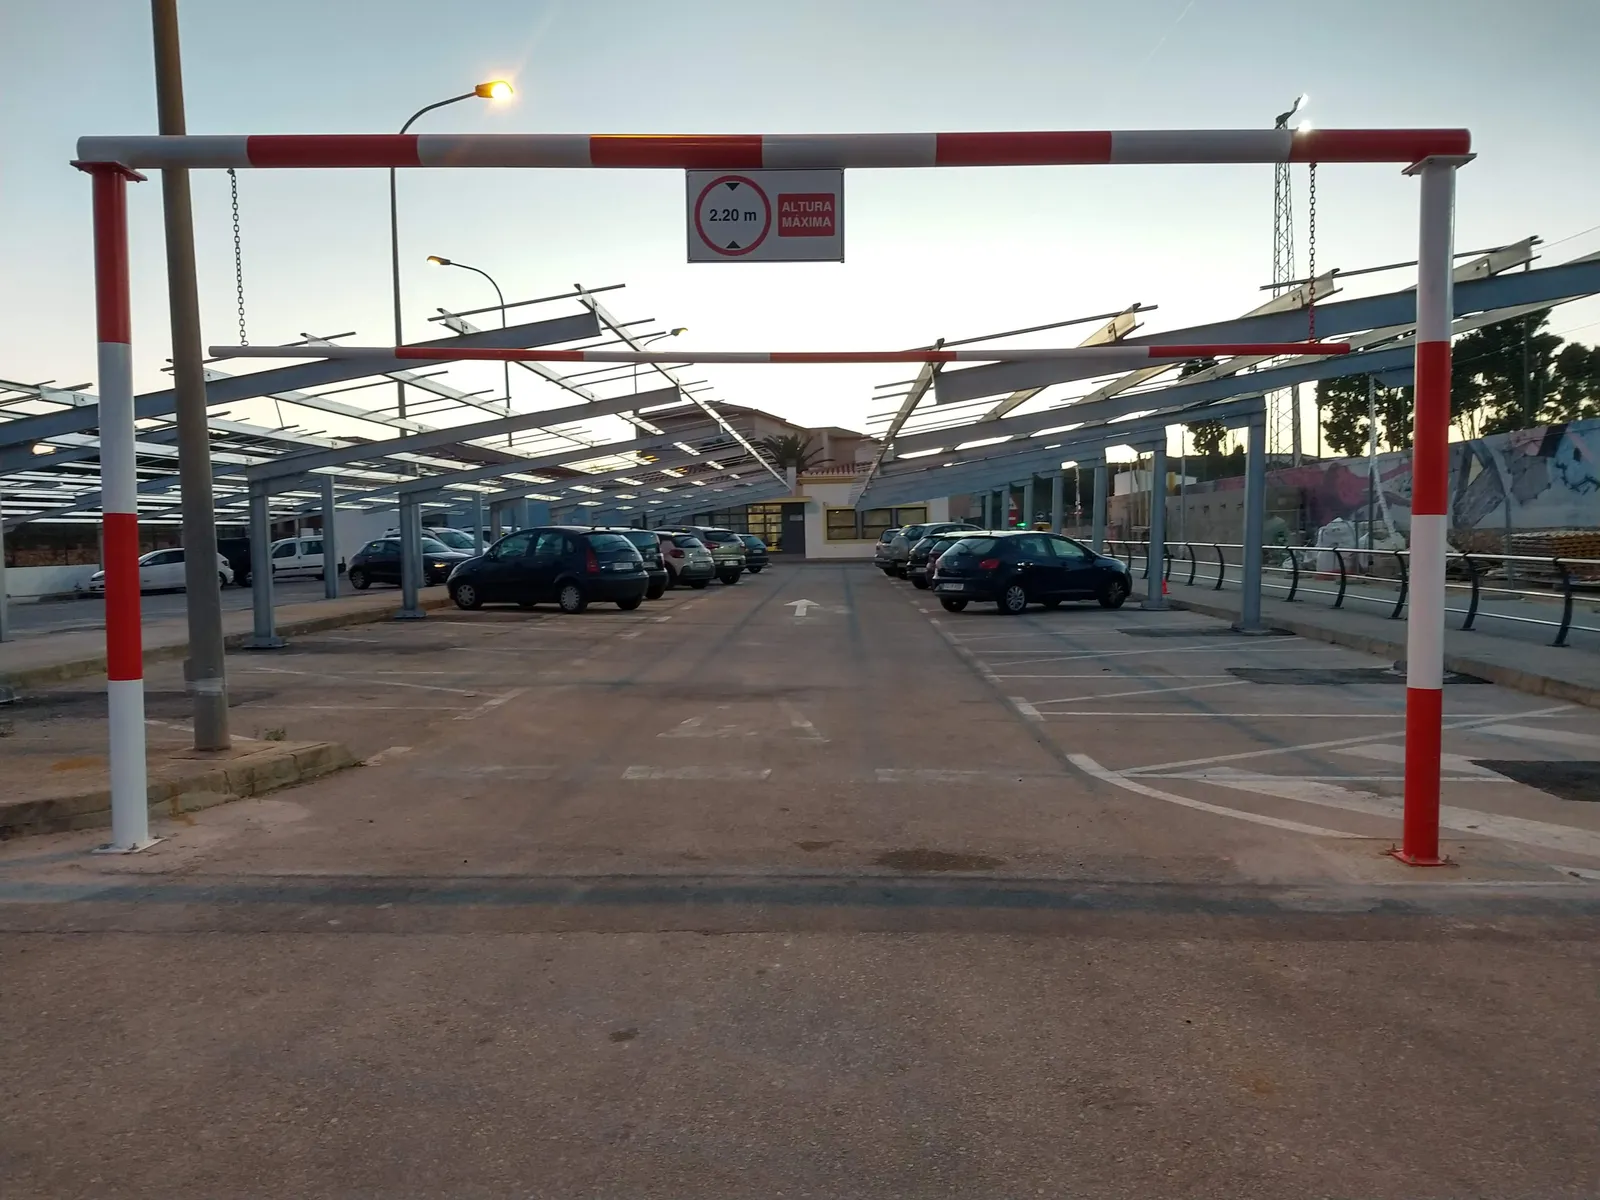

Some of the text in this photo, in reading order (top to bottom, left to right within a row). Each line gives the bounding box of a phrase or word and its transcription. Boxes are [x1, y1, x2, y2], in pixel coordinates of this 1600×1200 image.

[782, 201, 832, 212] ALTURA
[709, 208, 757, 221] 2.20 m
[782, 214, 832, 227] MÁXIMA
